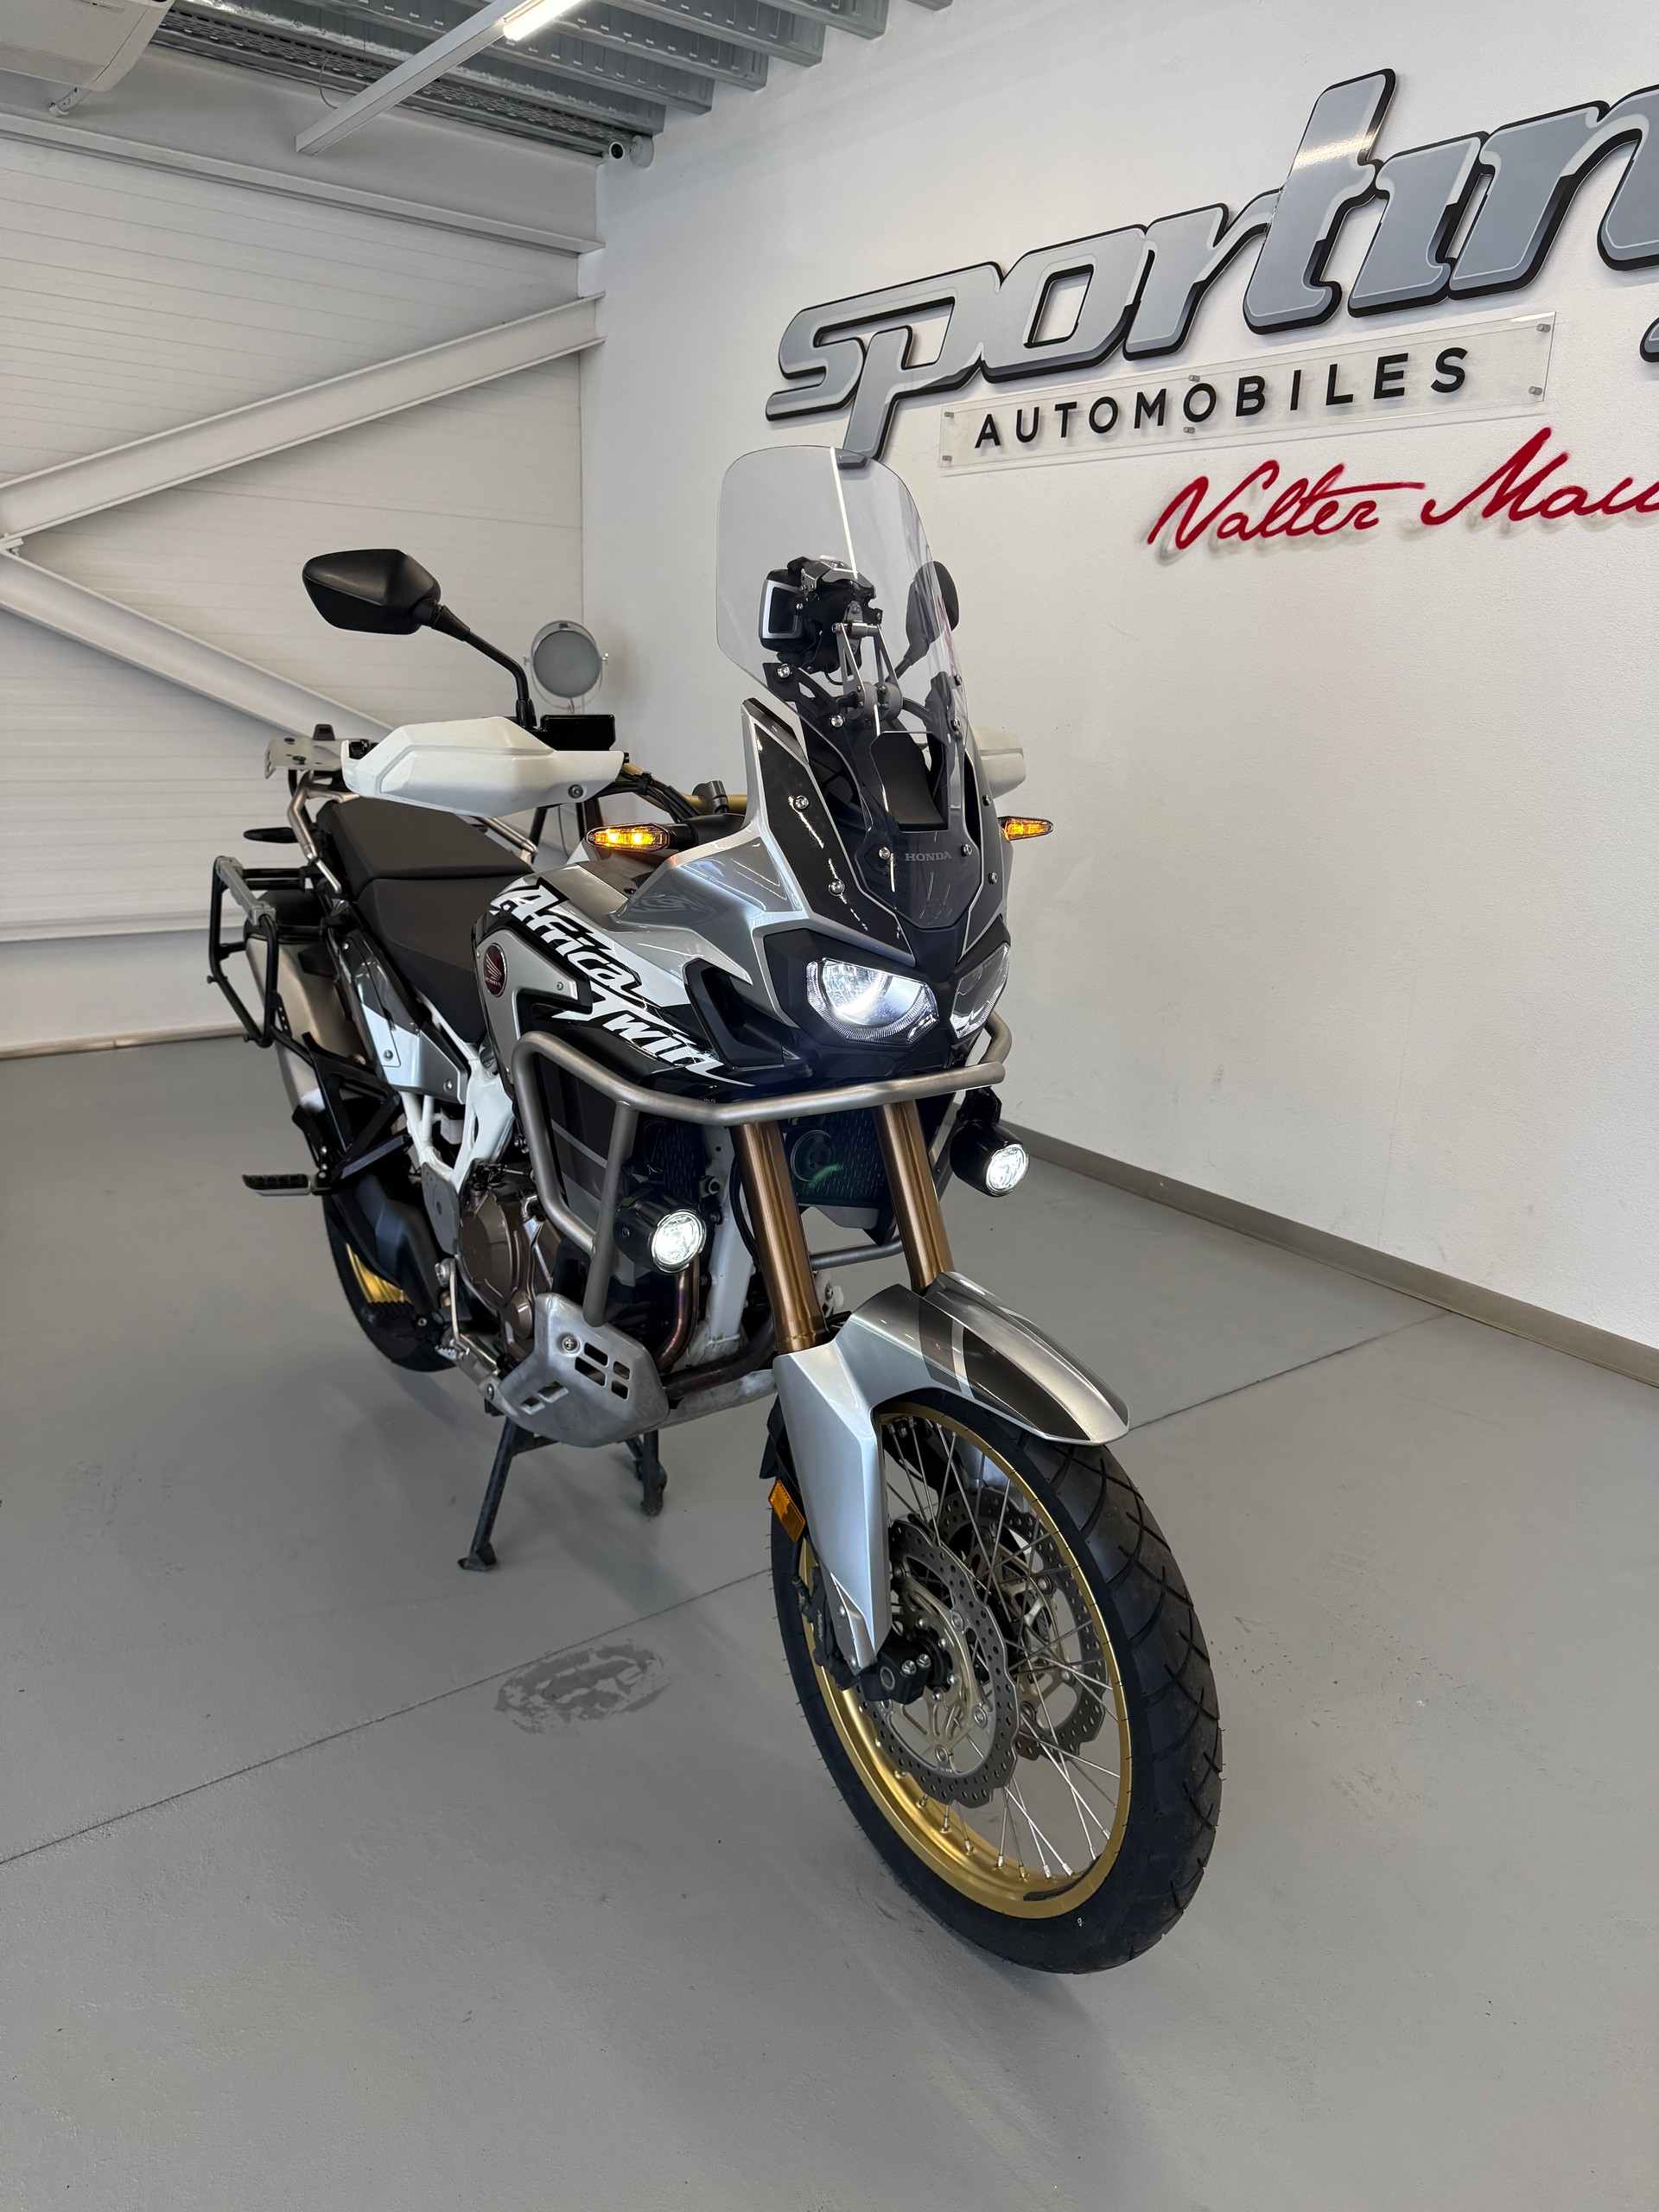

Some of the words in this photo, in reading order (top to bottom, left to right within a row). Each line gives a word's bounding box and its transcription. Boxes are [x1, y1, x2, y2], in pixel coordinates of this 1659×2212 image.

[766, 68, 1659, 470] sportin
[974, 347, 1469, 449] AUTOMOBILES
[904, 851, 953, 861] HONDA
[490, 883, 650, 1004] Africa
[550, 983, 755, 1088] Twin
